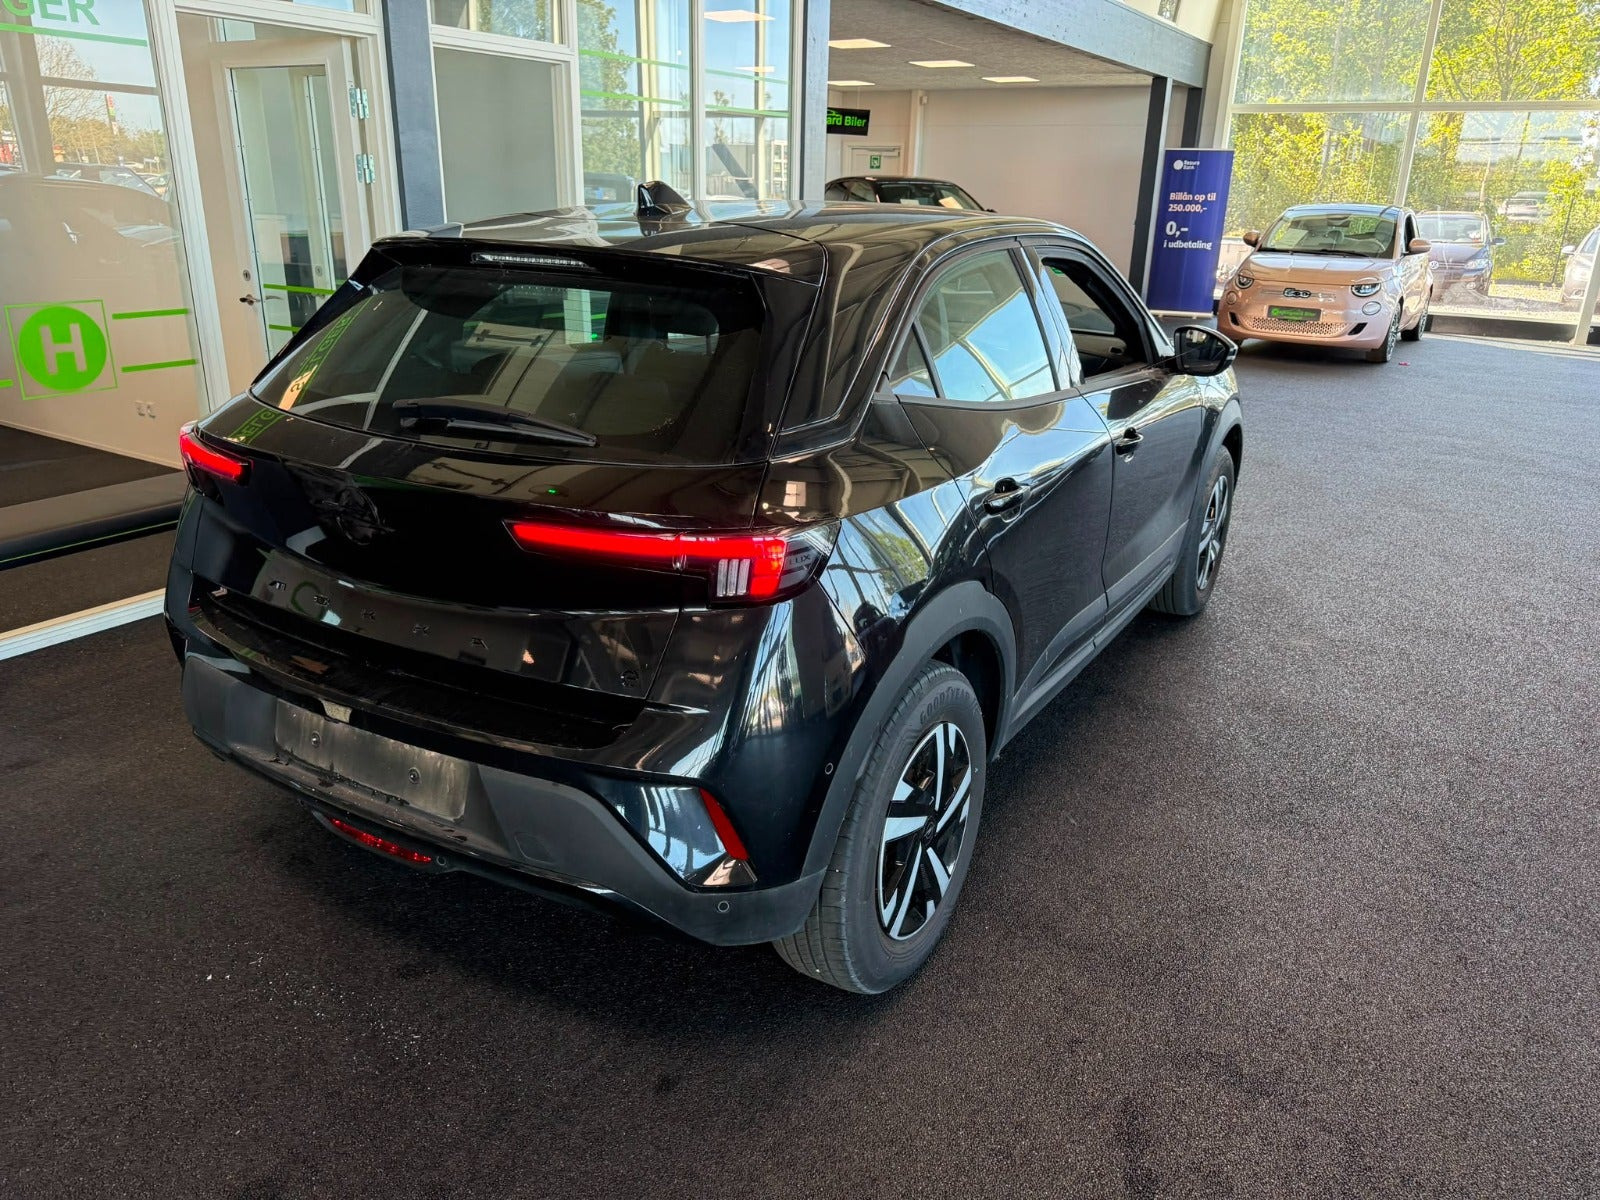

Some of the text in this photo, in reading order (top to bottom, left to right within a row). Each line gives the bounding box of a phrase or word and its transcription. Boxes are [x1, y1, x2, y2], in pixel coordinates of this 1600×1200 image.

[844, 115, 867, 127] Biler
[1169, 192, 1217, 203] Billån op til
[1168, 240, 1212, 250] udbetaling
[39, 322, 88, 376] H
